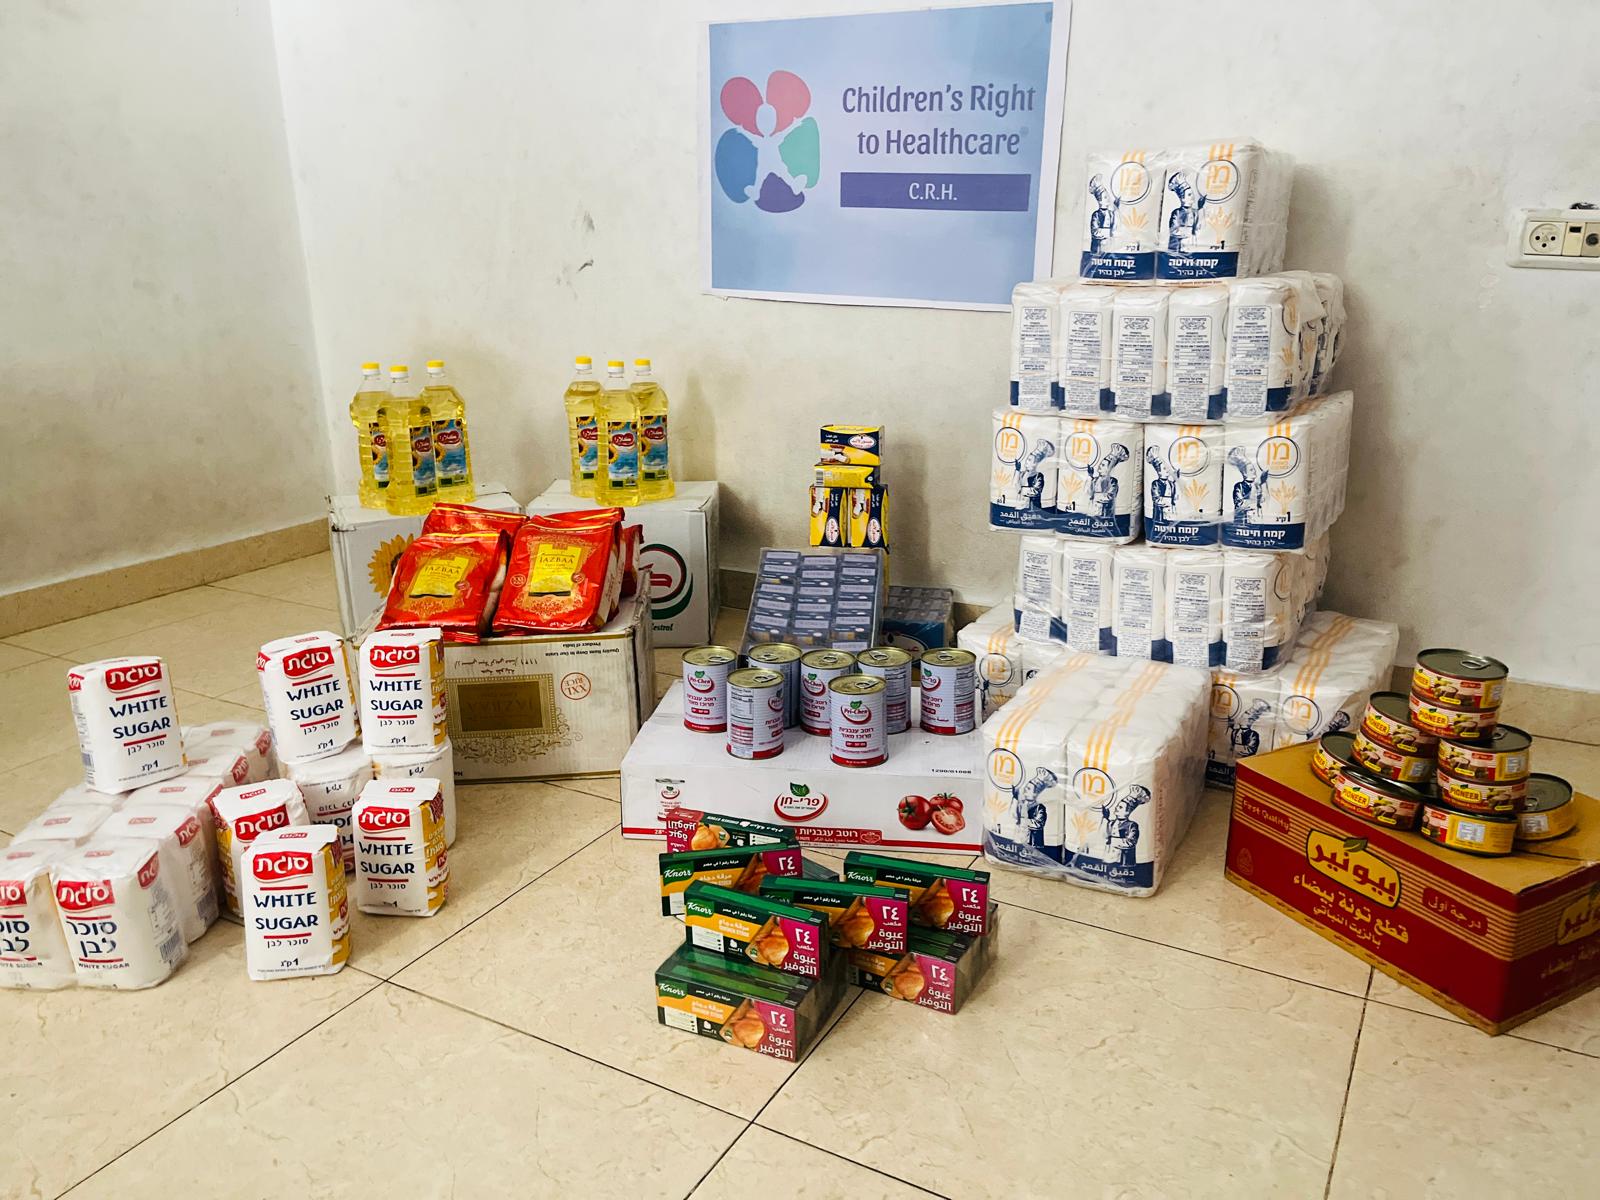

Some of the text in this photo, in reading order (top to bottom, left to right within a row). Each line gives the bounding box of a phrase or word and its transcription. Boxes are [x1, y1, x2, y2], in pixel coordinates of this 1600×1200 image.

[842, 83, 1036, 117] Children's Right
[857, 127, 1020, 156] to Healthcare
[908, 182, 957, 201] C.R.H.
[1091, 258, 1135, 269] קמח חיטה
[1168, 258, 1218, 269] קמח חיטה
[1000, 432, 1019, 452] מן
[1071, 437, 1092, 457] מן
[1177, 439, 1200, 465] מן
[1266, 441, 1290, 466] מן
[1068, 518, 1114, 530] دقيق القمح
[1286, 511, 1291, 522] 1
[1153, 524, 1199, 535] קמח חיטה
[1235, 528, 1286, 538] קמח חיטה
[539, 555, 574, 565] JAZBAA
[286, 650, 330, 672] סוגת
[372, 648, 417, 664] סוגת
[109, 664, 160, 686] סוגת
[563, 676, 584, 687] RICE
[286, 679, 342, 702] WHITE
[370, 679, 422, 692] WHITE
[564, 684, 587, 696] XXL
[109, 695, 169, 718] WHITE
[290, 697, 344, 721] SUGAR
[371, 698, 423, 711] SUGAR
[842, 707, 868, 716] Pri-Chen
[379, 719, 415, 728] סוכר לבן
[1418, 708, 1448, 727] PIONEER
[112, 715, 171, 739] SUGAR
[303, 720, 340, 735] סוכר לבן
[859, 726, 874, 735] רוטב
[329, 738, 334, 746] 1
[402, 735, 407, 743] 1
[127, 740, 166, 757] סוכר לבן
[153, 759, 159, 768] 1
[993, 753, 1015, 776] מן
[1082, 772, 1106, 795] מן
[780, 795, 820, 807] פרי-חן
[1342, 788, 1368, 807] PIONEER
[1450, 787, 1480, 802] PIONEER
[238, 810, 286, 837] סוגת
[362, 810, 407, 826] סוגת
[1242, 799, 1290, 834] First Quality
[667, 818, 697, 832] التوفير
[799, 827, 859, 838] רוטב עגבניות
[668, 829, 689, 843] عبوة
[358, 841, 414, 856] WHITE
[256, 856, 309, 875] סוגת
[360, 861, 416, 876] SUGAR
[778, 856, 796, 871] ٢٤
[1080, 861, 1135, 879] دقيق القمح
[664, 868, 692, 881] Knorr
[846, 871, 874, 884] Knorr
[1309, 843, 1397, 904] بيونير
[370, 882, 407, 891] סוכר לבן
[58, 884, 111, 910] סוגת
[253, 891, 317, 908] WHITE
[961, 887, 979, 903] ٢٤
[686, 901, 714, 916] Knorr
[882, 905, 900, 922] ٢٤
[958, 910, 983, 922] عبوة
[1293, 872, 1409, 945] قطع تونة بيضاء
[255, 914, 319, 931] SUGAR
[1449, 904, 1482, 930] درجة
[66, 919, 118, 938] סוכר
[947, 919, 983, 934] التوفير
[1312, 903, 1382, 953] بالزيت النباتي
[794, 928, 812, 945] ٢٤
[878, 929, 904, 941] عبوة
[80, 935, 117, 960] לבן
[267, 937, 309, 949] סוכר לבן
[796, 944, 815, 953] مكعب
[867, 939, 904, 952] التوفير
[78, 960, 100, 970] WHITE
[293, 957, 299, 966] 1
[793, 950, 817, 965] عبوة
[783, 961, 817, 979] التوفير
[930, 964, 949, 982] ٢٤
[659, 982, 686, 997] Knorr
[928, 986, 952, 1001] عبوة
[917, 994, 952, 1013] التوفير
[770, 1010, 788, 1028] ٢٤
[769, 1033, 793, 1048] عبوة
[759, 1043, 793, 1060] التوفير
